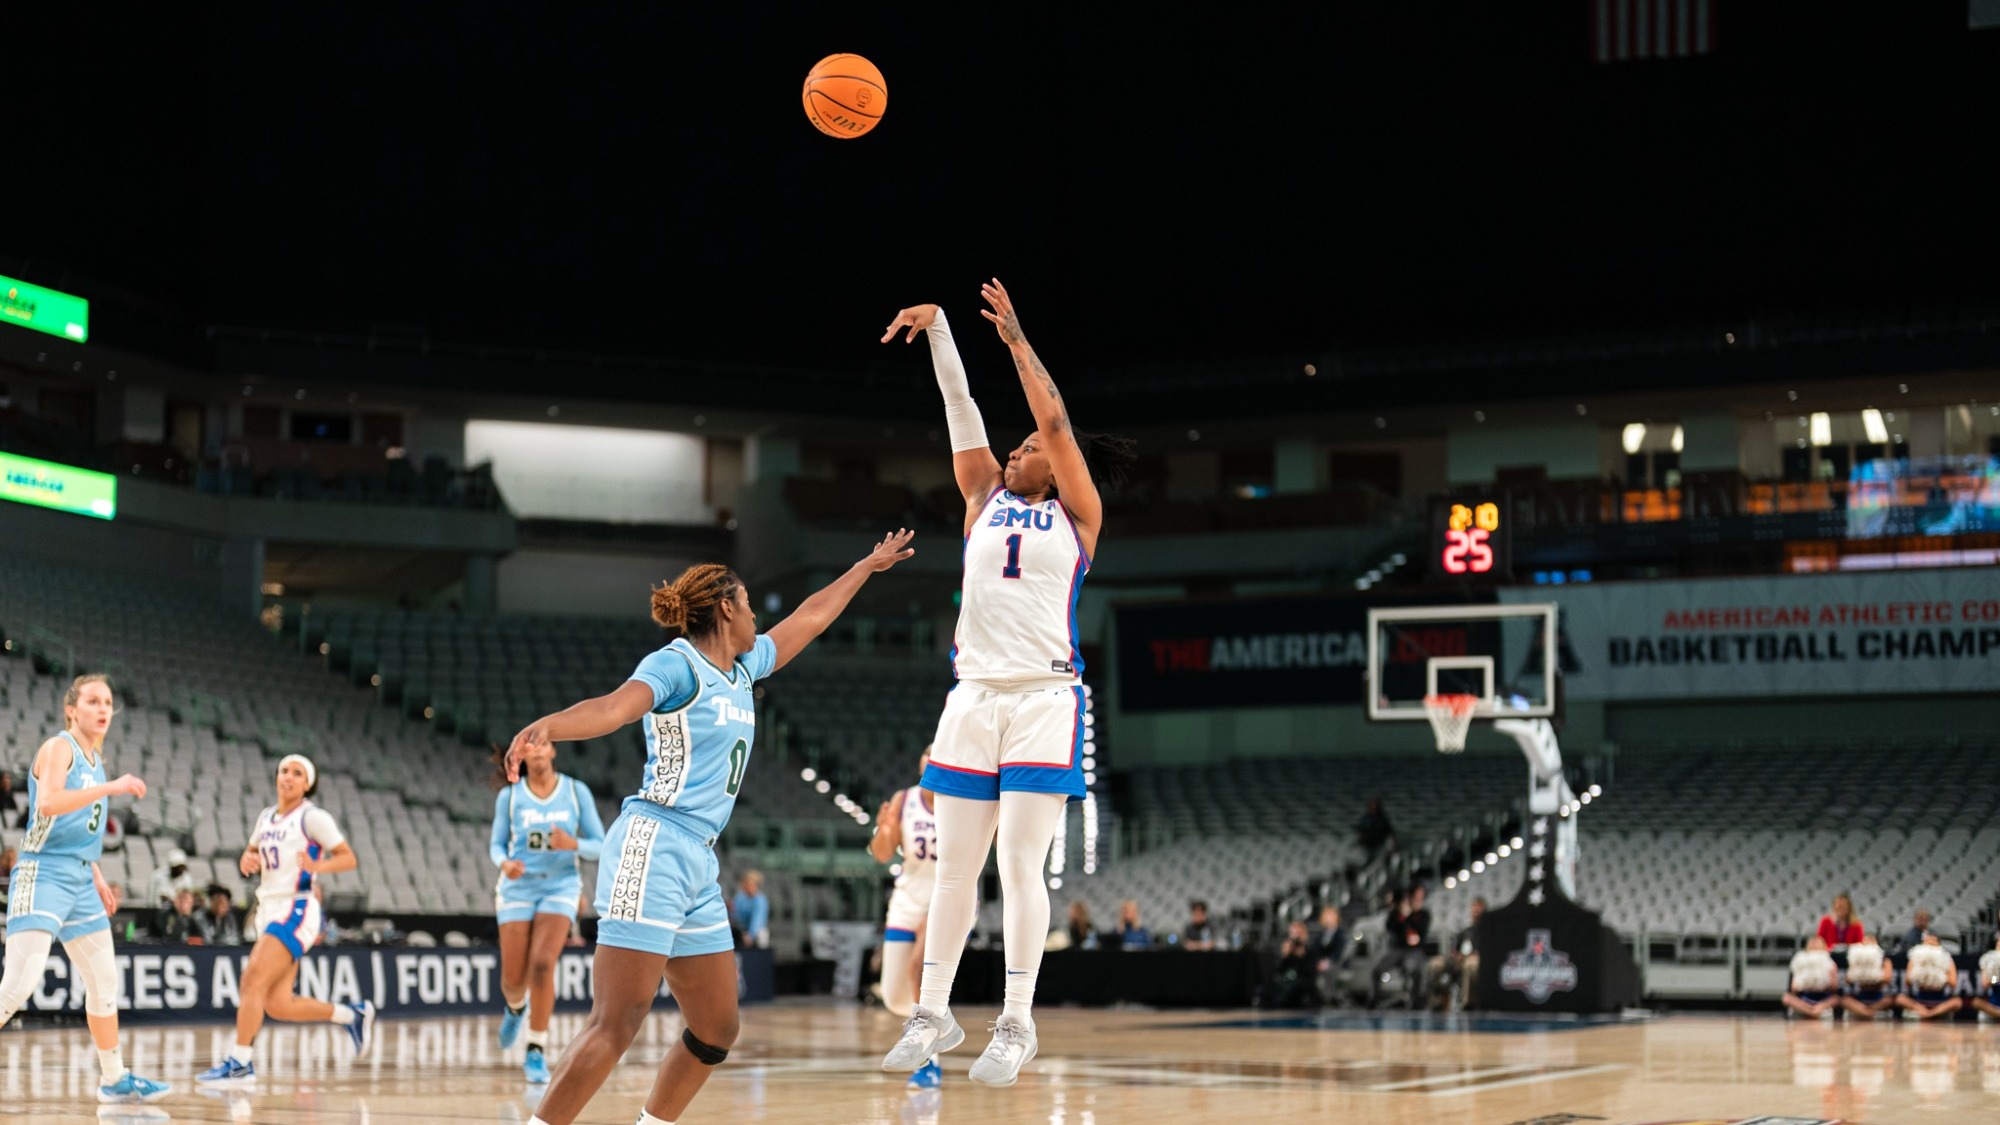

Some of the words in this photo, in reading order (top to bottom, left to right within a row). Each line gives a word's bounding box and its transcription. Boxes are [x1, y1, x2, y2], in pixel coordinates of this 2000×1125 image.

[988, 506, 1054, 532] SMU
[1002, 533, 1023, 580] 1
[1442, 528, 1493, 574] 25
[1663, 606, 1810, 631] AMERICAN
[1818, 601, 1953, 626] ATHLETIC
[1607, 632, 1847, 667] BASKETBALL
[1857, 627, 2000, 661] CHAMP
[724, 736, 748, 798] 0
[87, 800, 103, 836] 3
[261, 845, 280, 871] 13
[395, 954, 498, 1004] FORT
